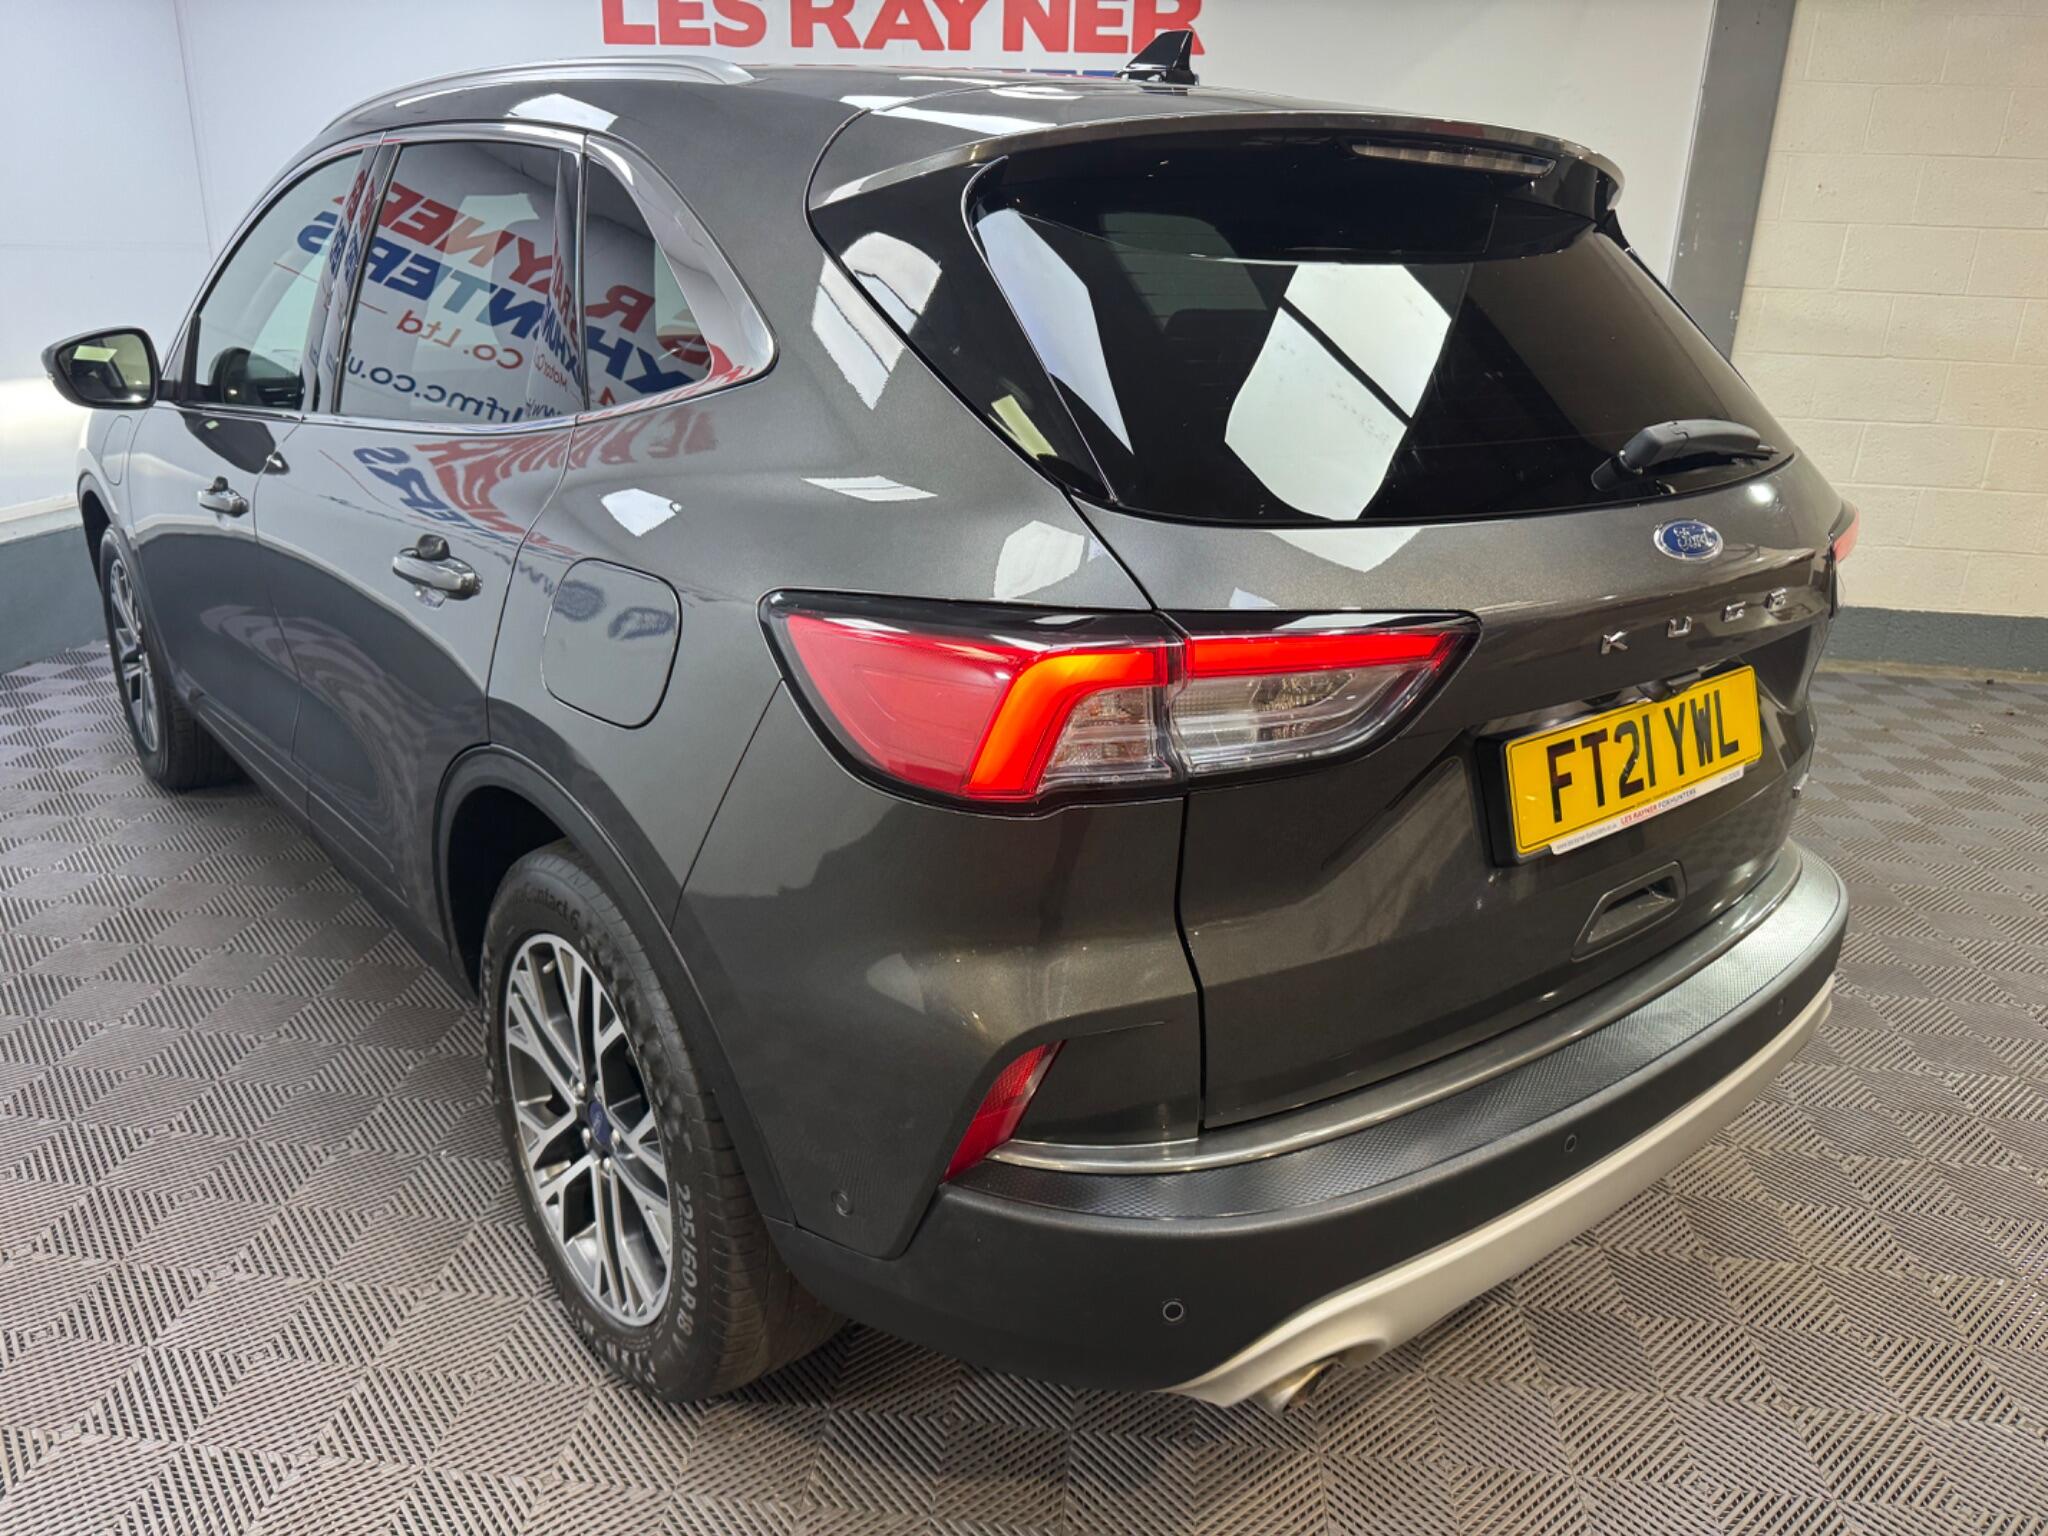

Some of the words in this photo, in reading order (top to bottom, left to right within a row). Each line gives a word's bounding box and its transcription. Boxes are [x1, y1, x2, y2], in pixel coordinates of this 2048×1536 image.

[602, 0, 767, 48] LES
[1672, 526, 1715, 551] Ford
[1546, 714, 1657, 823] FT21
[1664, 689, 1739, 777] YWL
